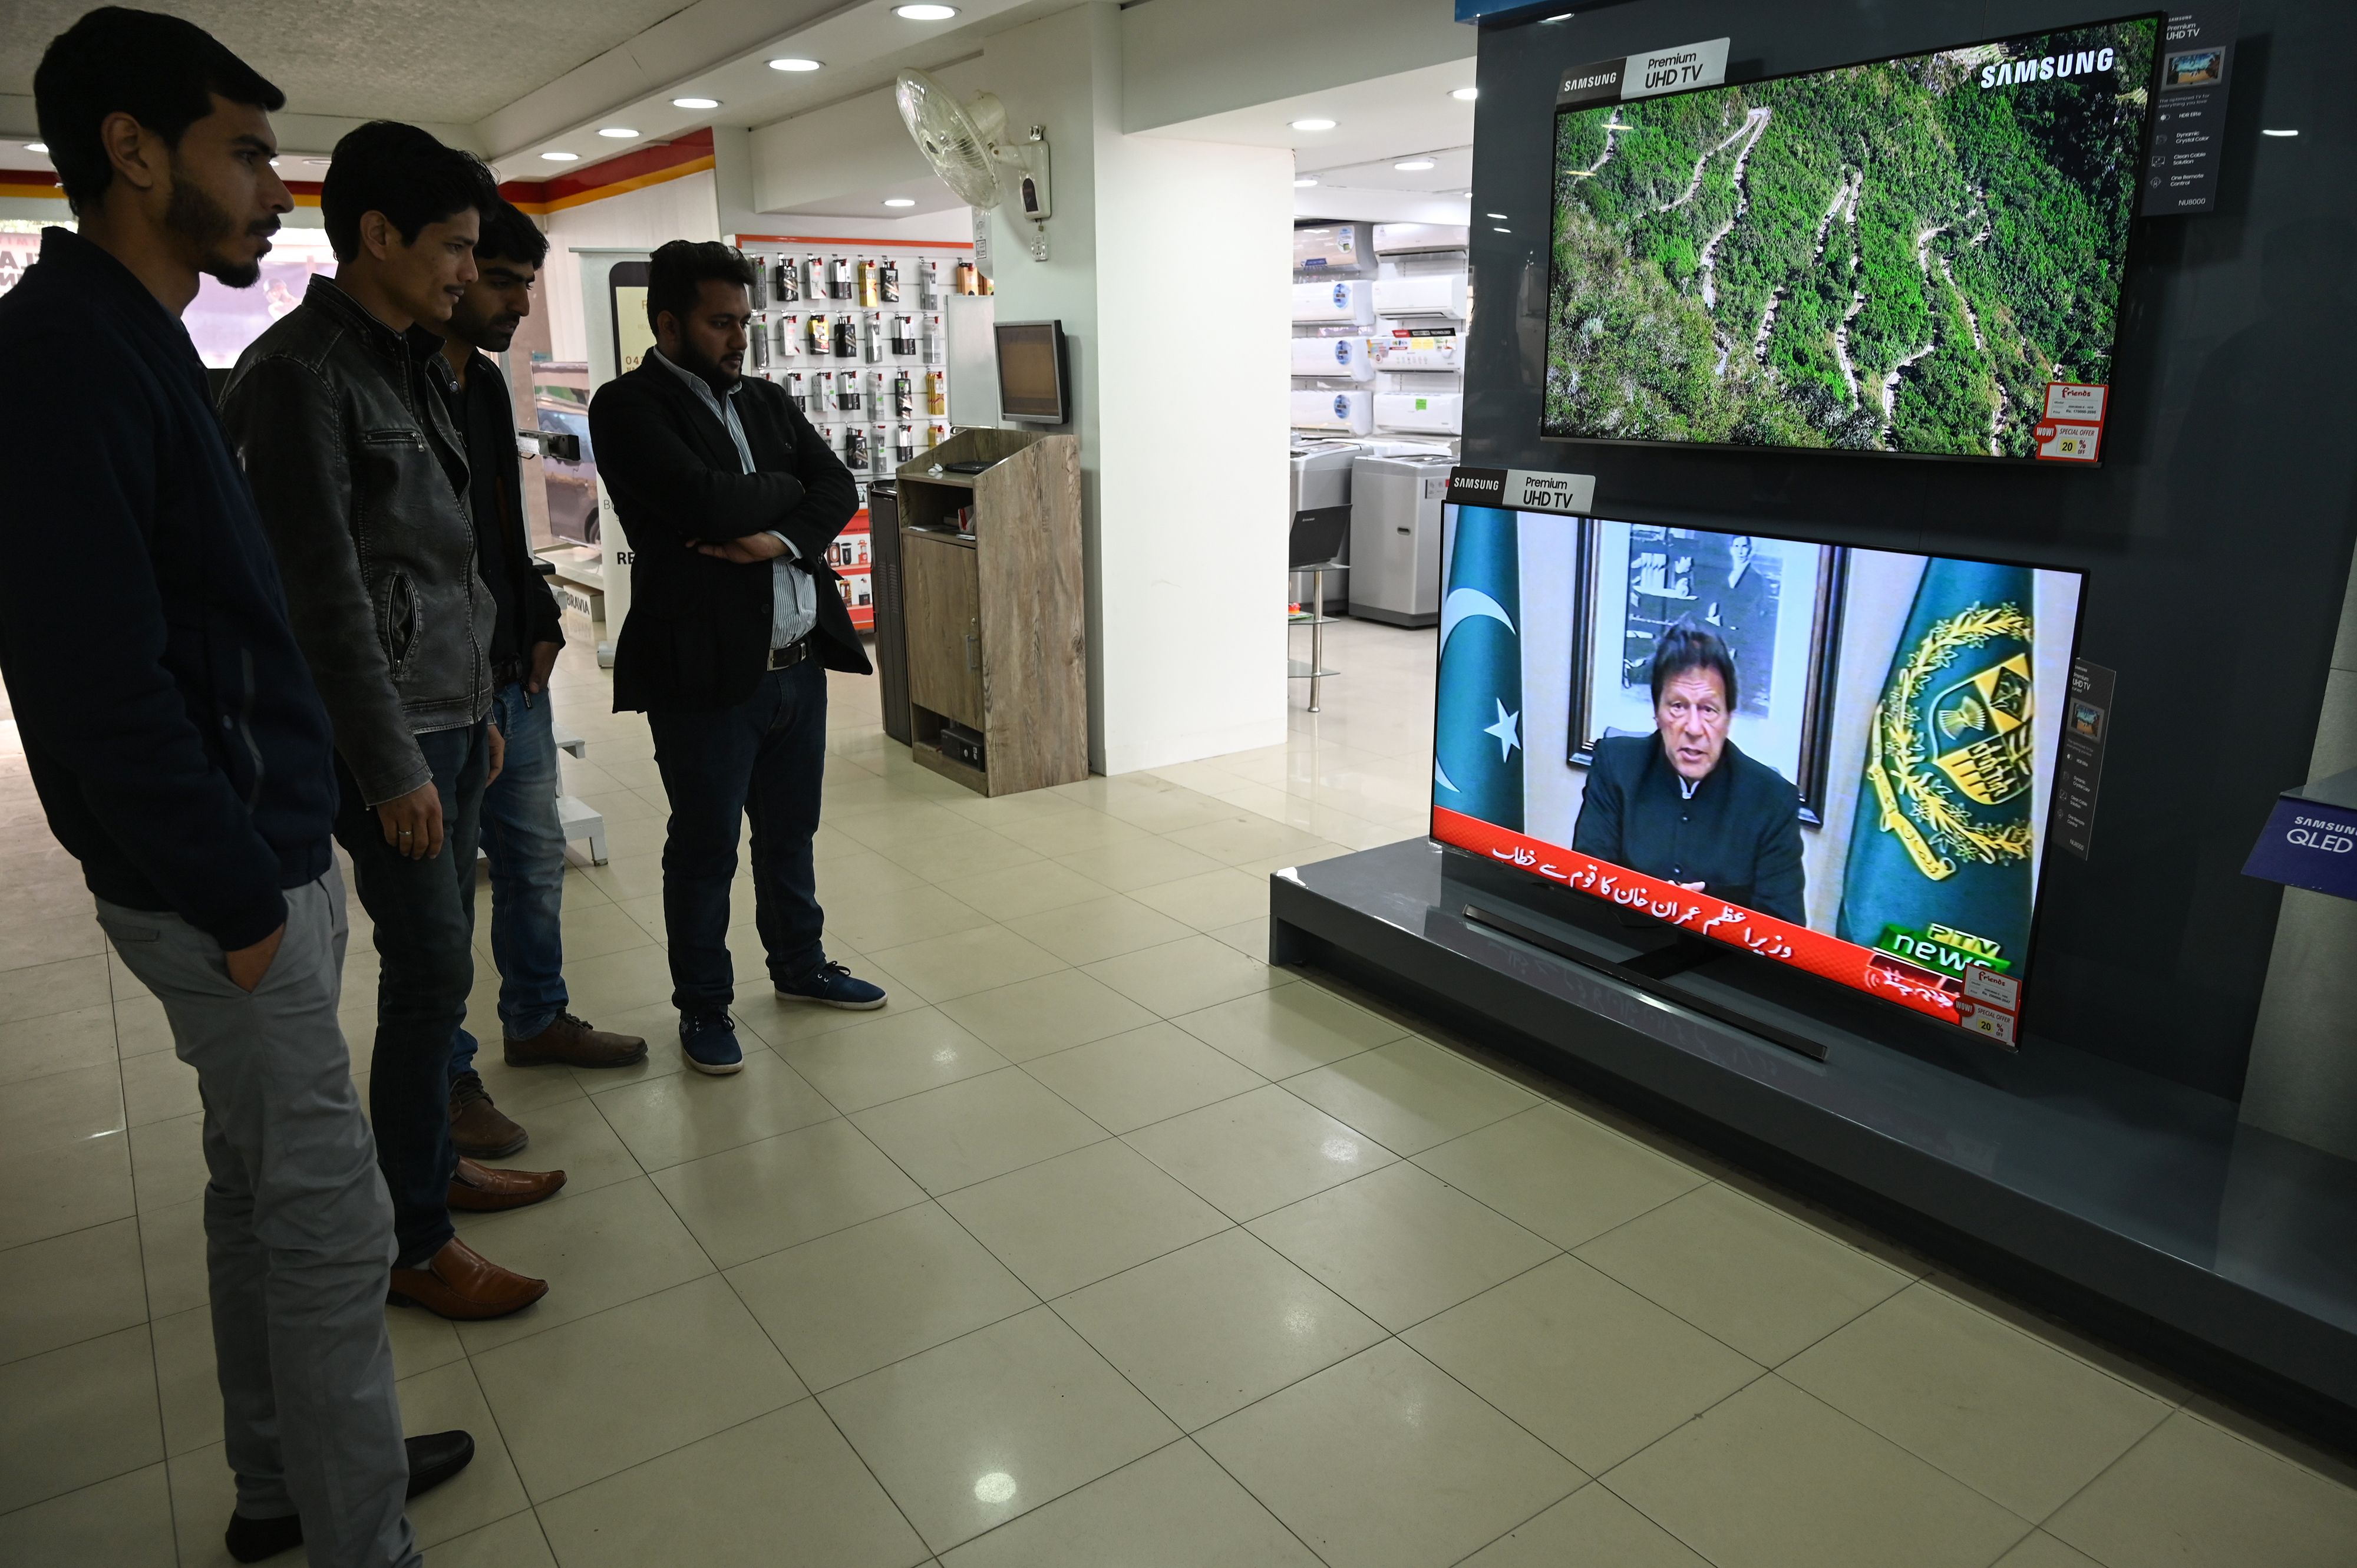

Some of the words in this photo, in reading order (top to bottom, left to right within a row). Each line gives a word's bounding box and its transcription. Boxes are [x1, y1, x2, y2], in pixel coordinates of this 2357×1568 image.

[2166, 31, 2186, 41] UHD
[2187, 28, 2200, 38] TV
[2167, 23, 2196, 32] Premium
[1648, 52, 1696, 70] Premium
[1980, 48, 2114, 88] SAMSUNG
[1564, 72, 1616, 91] SAMSUNG
[1645, 67, 1678, 88] UHD
[1681, 64, 1704, 83] TV
[2178, 198, 2206, 206] NU8000
[2036, 427, 2054, 437] WOW!
[2062, 442, 2073, 451] 20
[2079, 440, 2086, 449] %
[1454, 477, 1499, 491] SAMSUNG
[1526, 477, 1567, 490] Premium
[1523, 490, 1551, 506] UHD
[1554, 492, 1573, 509] TV
[566, 593, 590, 615] BRAVIA
[2072, 678, 2083, 688] UHD
[2084, 681, 2091, 691] TV
[2295, 816, 2357, 836] SAMSUN
[2286, 828, 2353, 853] QLED
[1493, 846, 1536, 866] خطاب
[1539, 863, 1567, 879] سے
[1570, 864, 1598, 888] قوم
[1600, 876, 1618, 895] کا
[1613, 887, 1649, 907] خان
[1651, 902, 1701, 925] عمران
[1929, 925, 1999, 955] PTV
[1956, 1001, 1972, 1013] WOW!
[1978, 1008, 1995, 1019] SPECIAL
[1996, 1014, 2011, 1024] OFFER
[1981, 1021, 1991, 1031] 20
[1996, 1023, 2003, 1032] %
